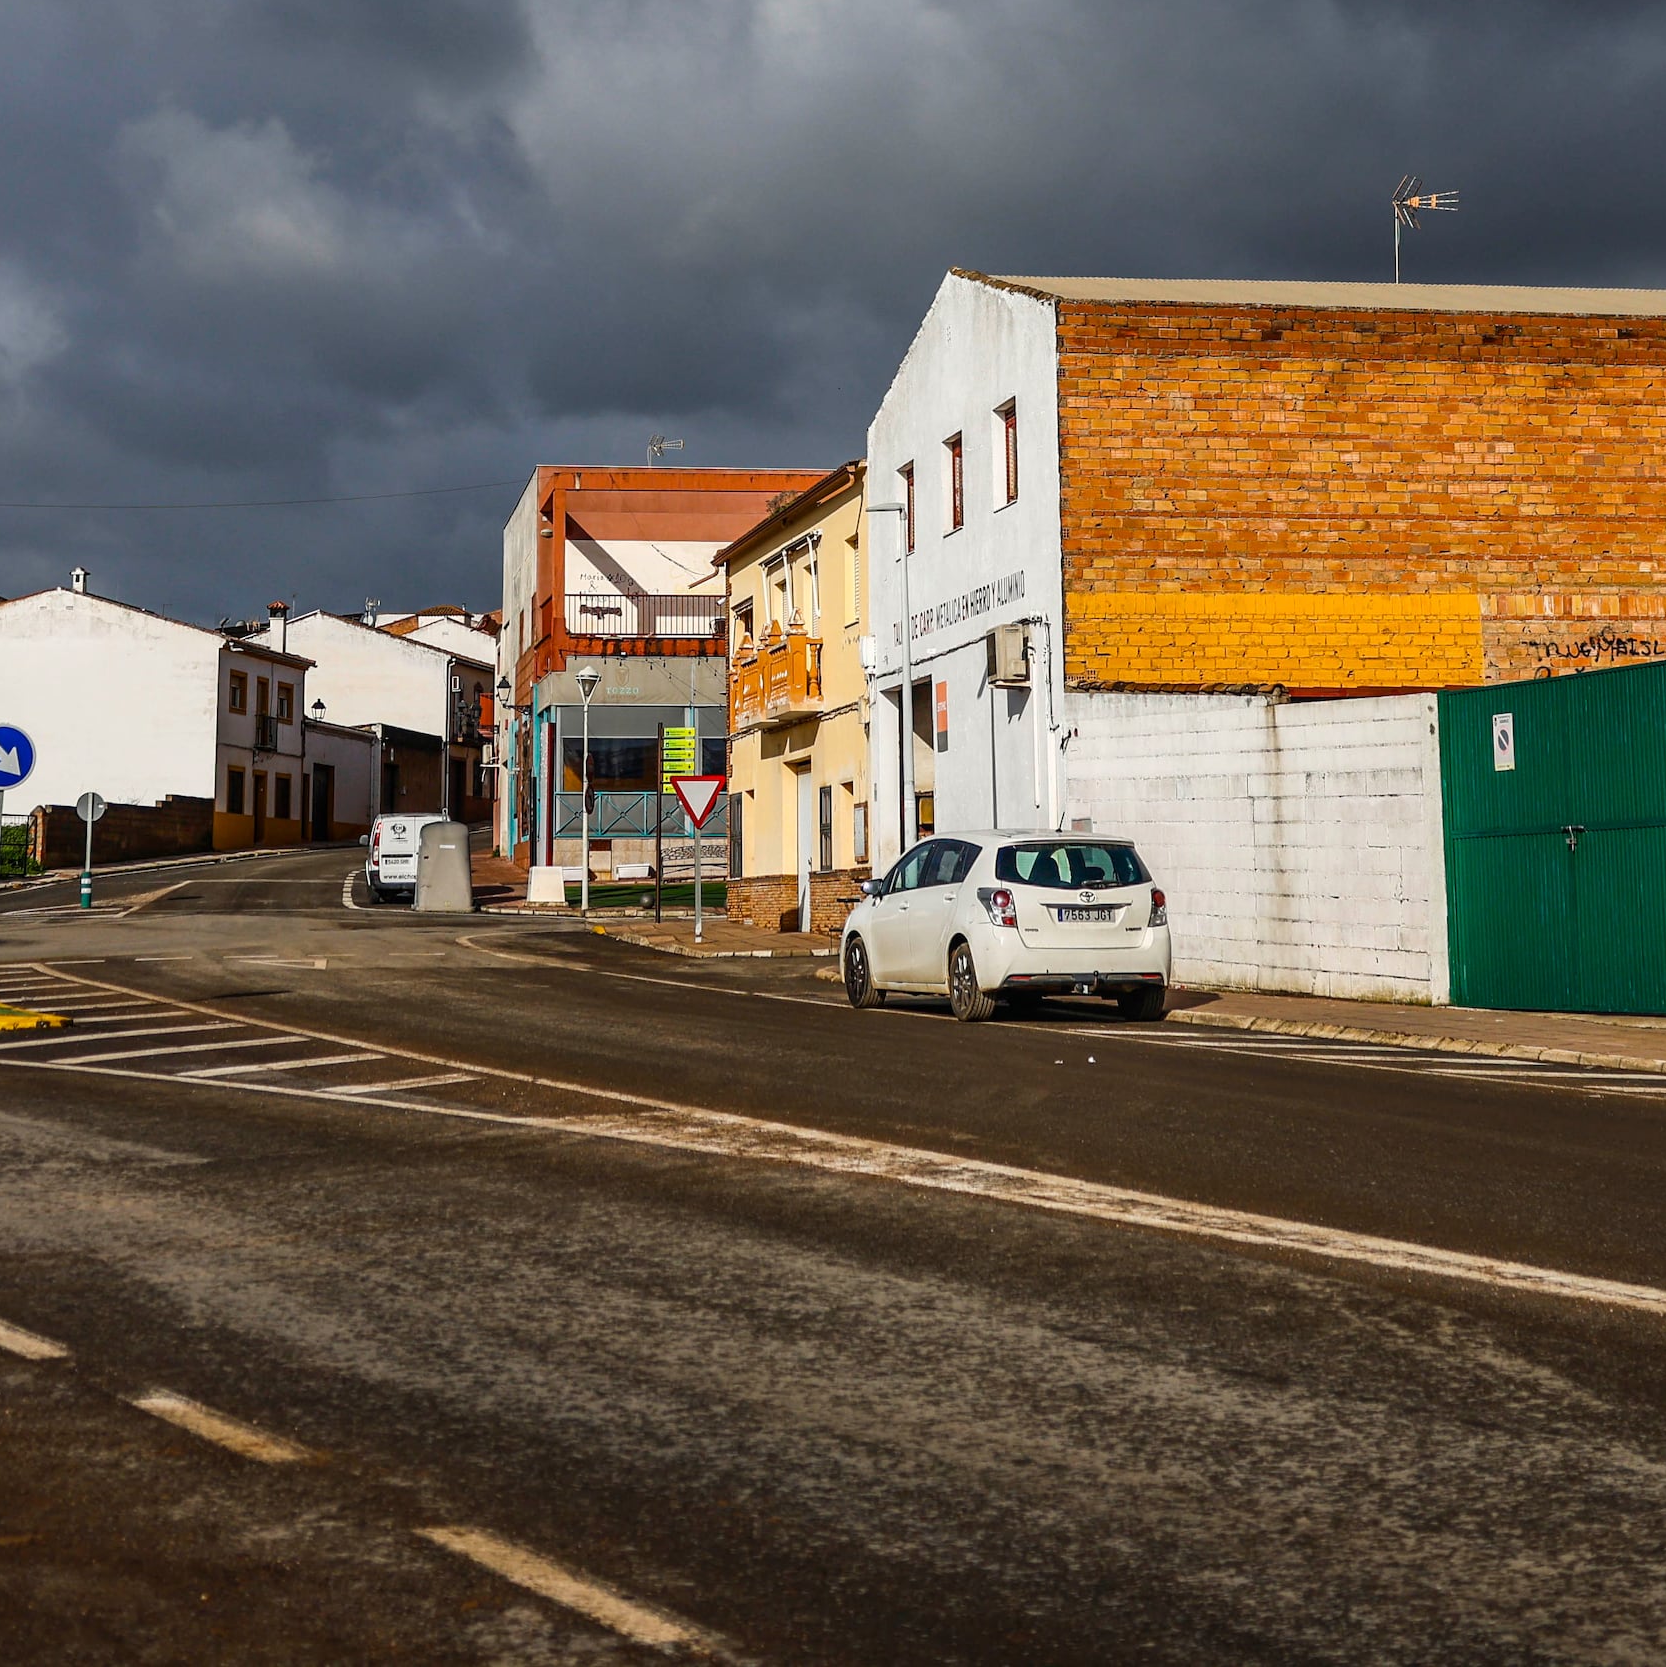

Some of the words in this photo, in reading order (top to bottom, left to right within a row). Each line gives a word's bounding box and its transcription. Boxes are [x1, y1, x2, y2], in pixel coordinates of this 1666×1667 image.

[910, 614, 918, 640] DE
[961, 594, 969, 622] EN
[970, 584, 991, 617] HIERRO
[996, 569, 1025, 607] ALUMINIO
[1065, 909, 1091, 921] 7563
[1094, 910, 1112, 921] JGT
